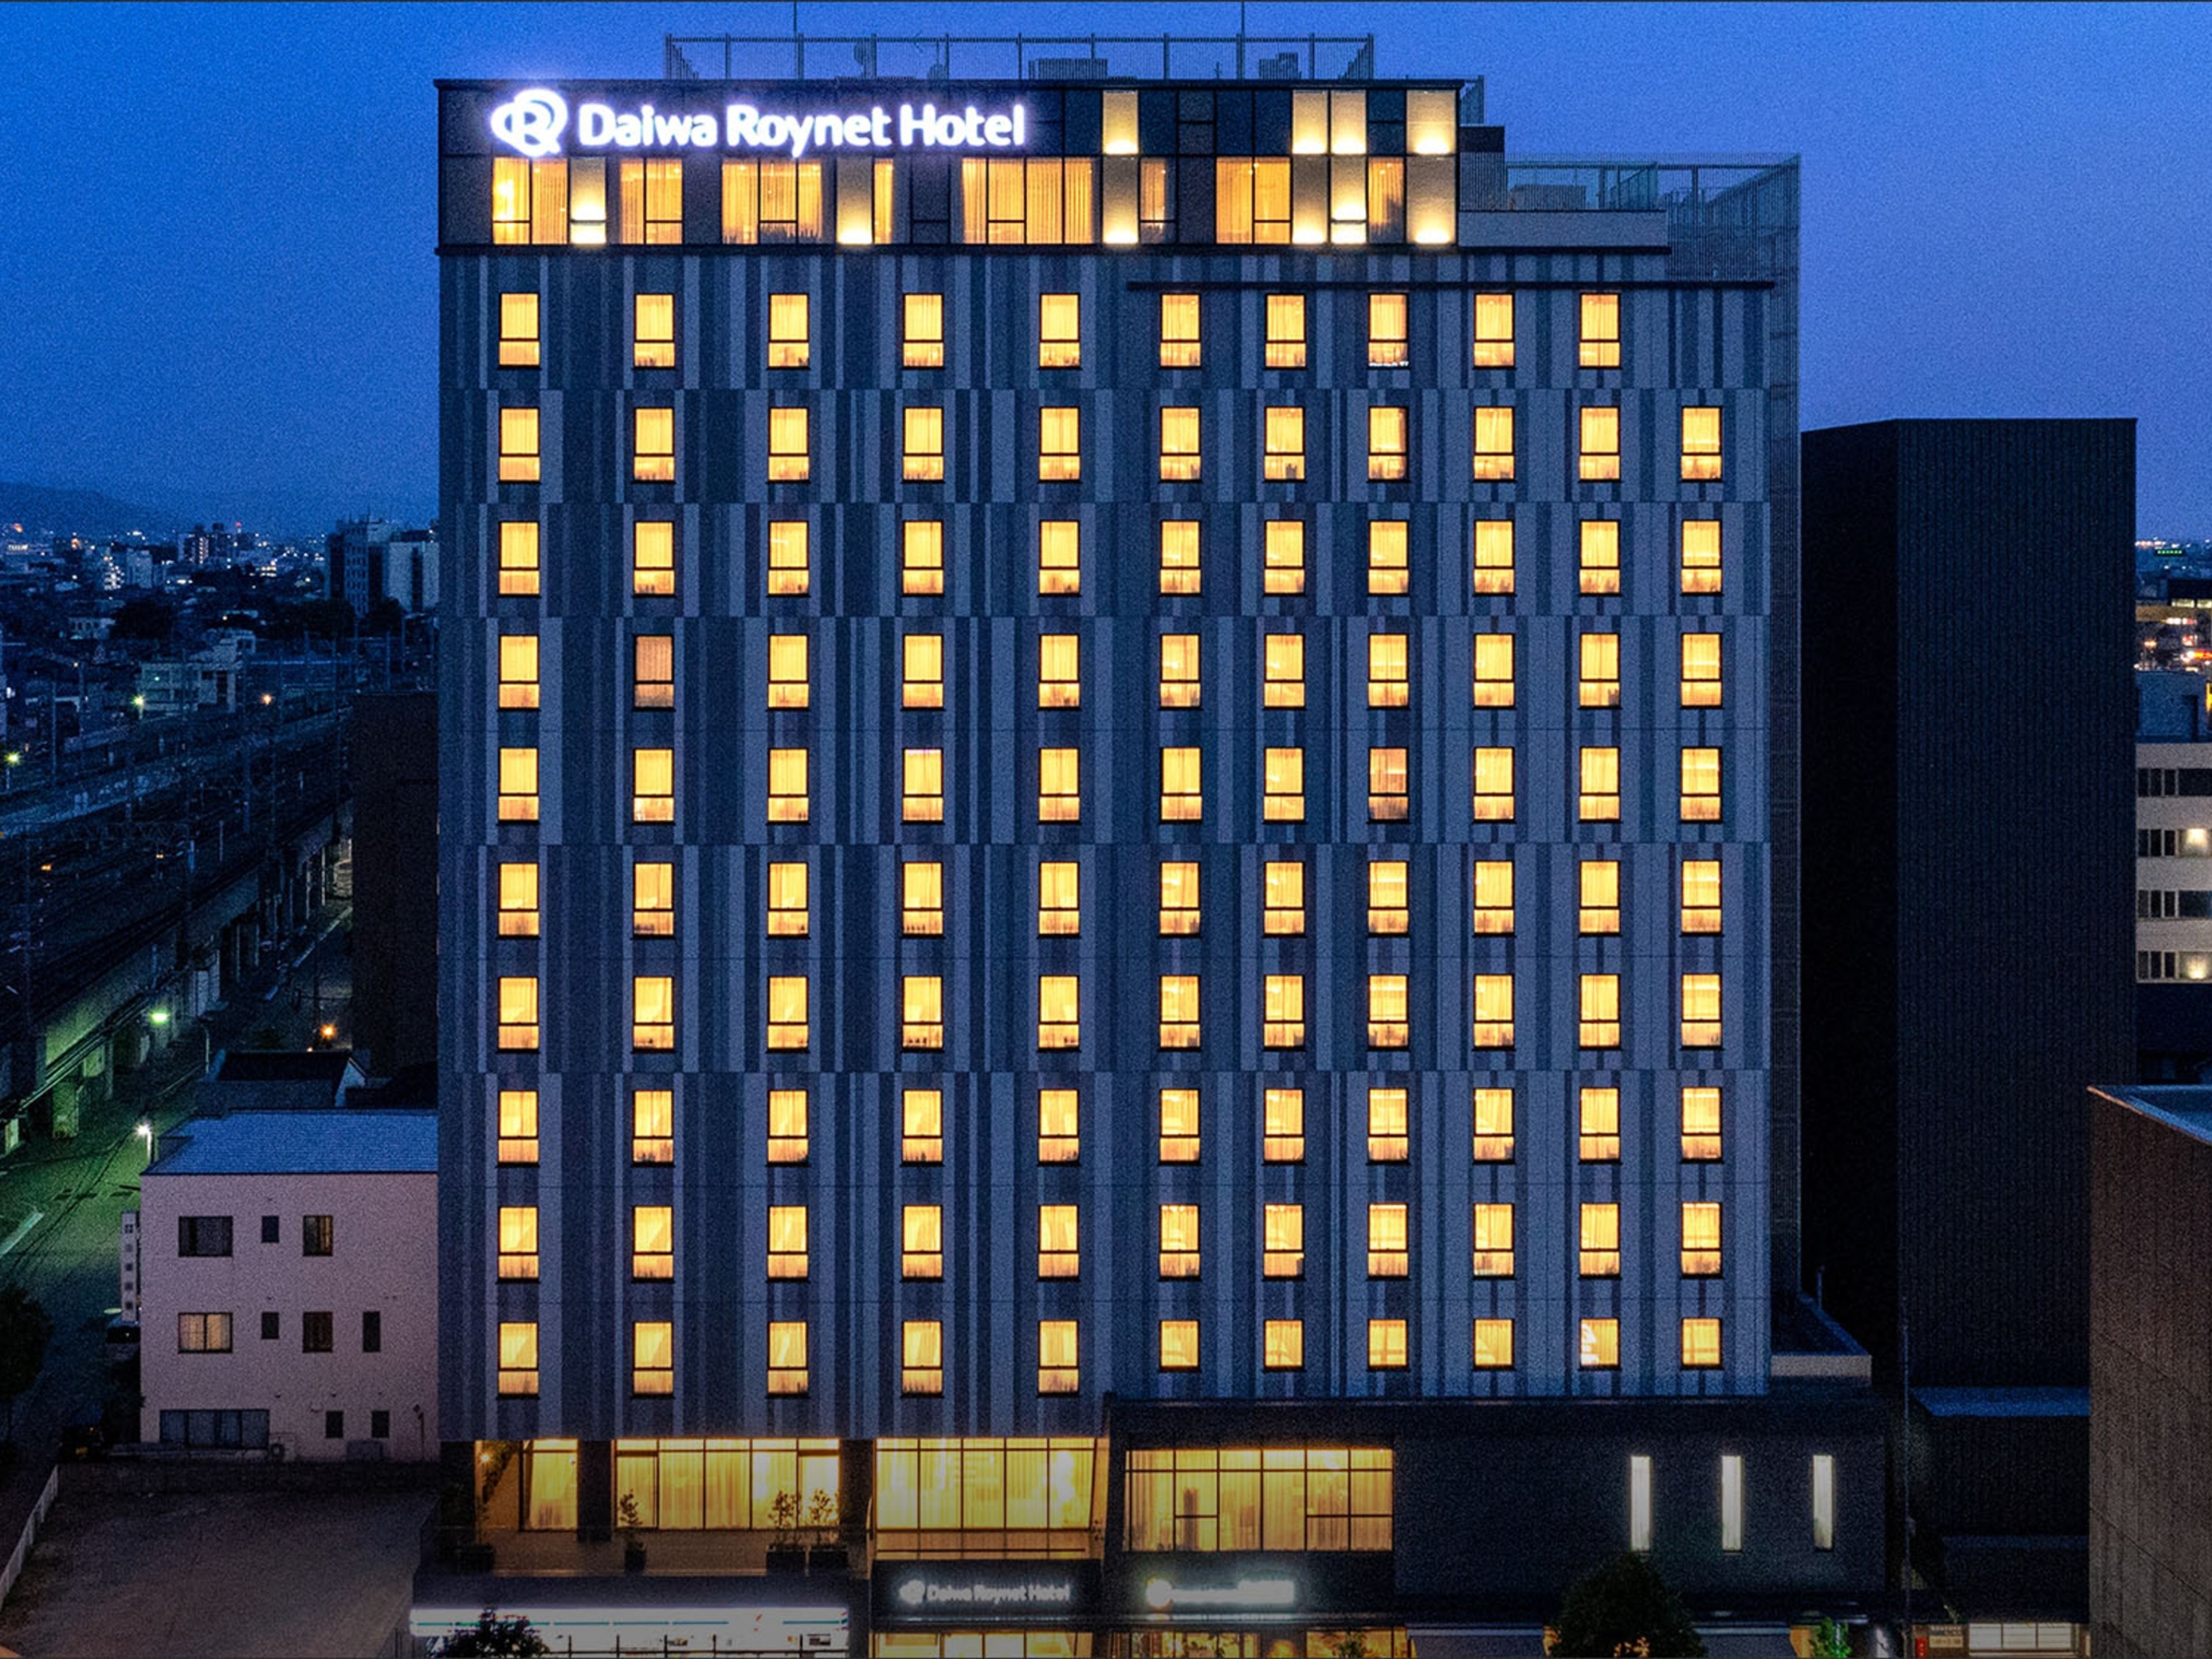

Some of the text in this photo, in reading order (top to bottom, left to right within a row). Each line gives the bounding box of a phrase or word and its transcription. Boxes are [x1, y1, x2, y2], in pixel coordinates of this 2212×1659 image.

[578, 103, 1025, 158] Daiwa Roynet Hotel
